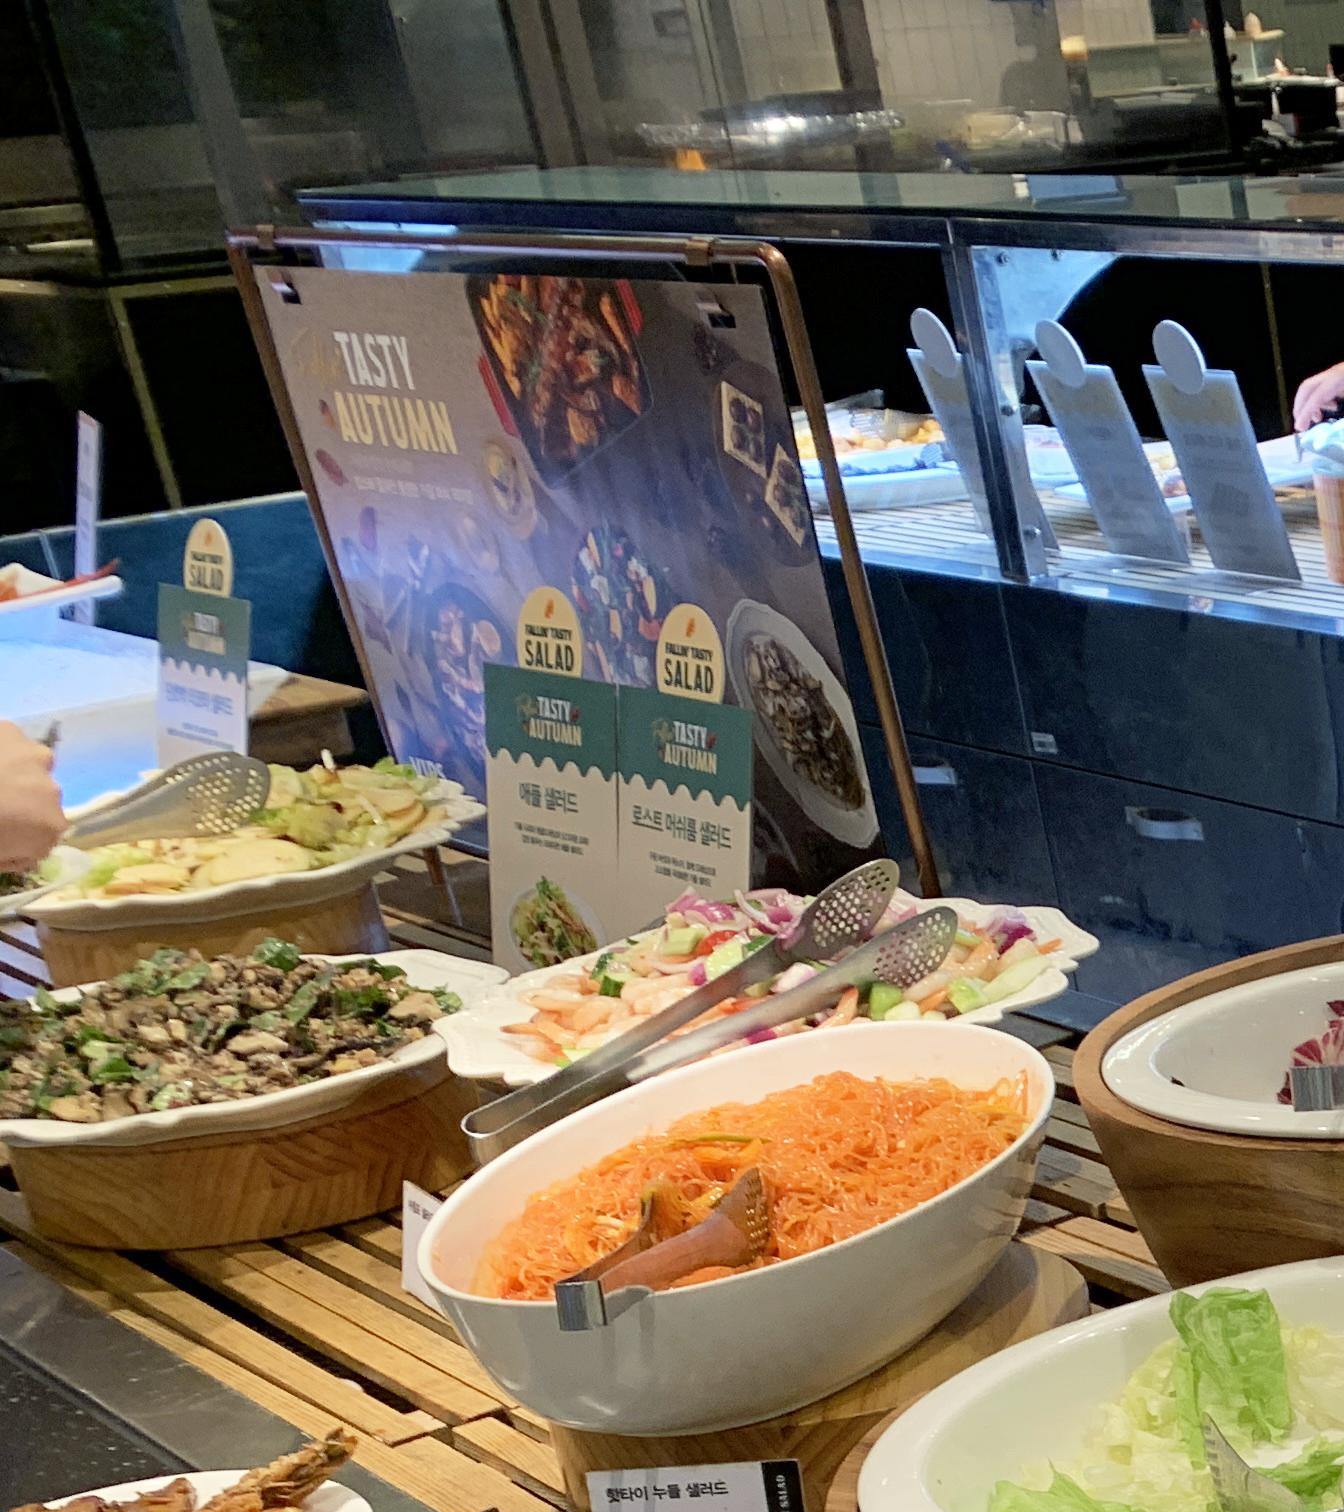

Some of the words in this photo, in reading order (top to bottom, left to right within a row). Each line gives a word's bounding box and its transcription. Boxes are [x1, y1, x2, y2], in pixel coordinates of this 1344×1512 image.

[332, 328, 416, 390] TASTY
[334, 390, 457, 455] AUTUMN
[550, 627, 573, 641] TASTY
[525, 640, 575, 672] SALAD
[691, 648, 714, 662] TASTY
[664, 658, 714, 694] SALAD
[536, 696, 571, 722] TASTY
[529, 717, 582, 746] AUTUMN
[673, 721, 707, 748] TASTY
[664, 743, 717, 775] AUTUMN
[544, 787, 579, 813] 샐러드
[632, 804, 664, 832] 로스트
[665, 813, 697, 842] 머쉬룸
[700, 821, 732, 849] 샐러드
[652, 1483, 681, 1500] 누들
[685, 1480, 729, 1498] 샐러드
[775, 1474, 790, 1508] SALAD
